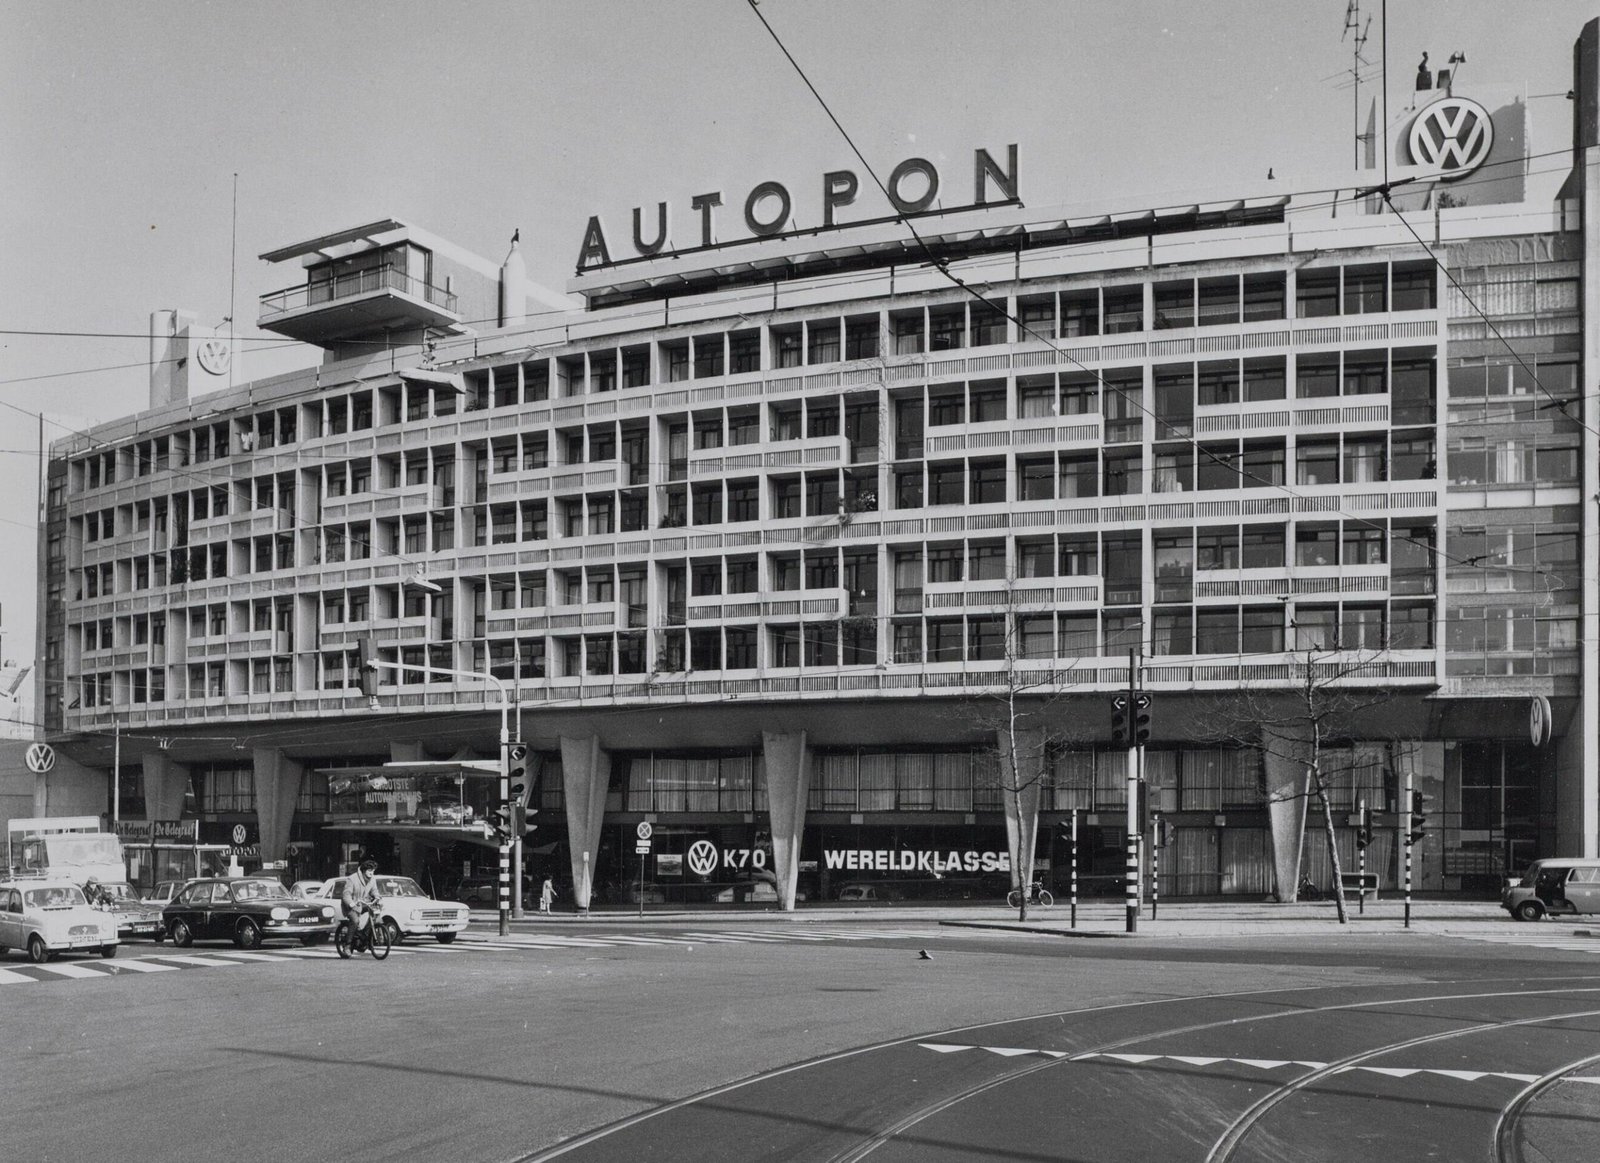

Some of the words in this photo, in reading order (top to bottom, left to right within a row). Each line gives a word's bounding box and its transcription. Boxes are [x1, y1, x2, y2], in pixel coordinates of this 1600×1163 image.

[577, 143, 1021, 268] AUTOPON
[165, 822, 194, 838] Telegraaf
[723, 849, 765, 868] K70
[824, 850, 1010, 872] WERELDKLASSE
